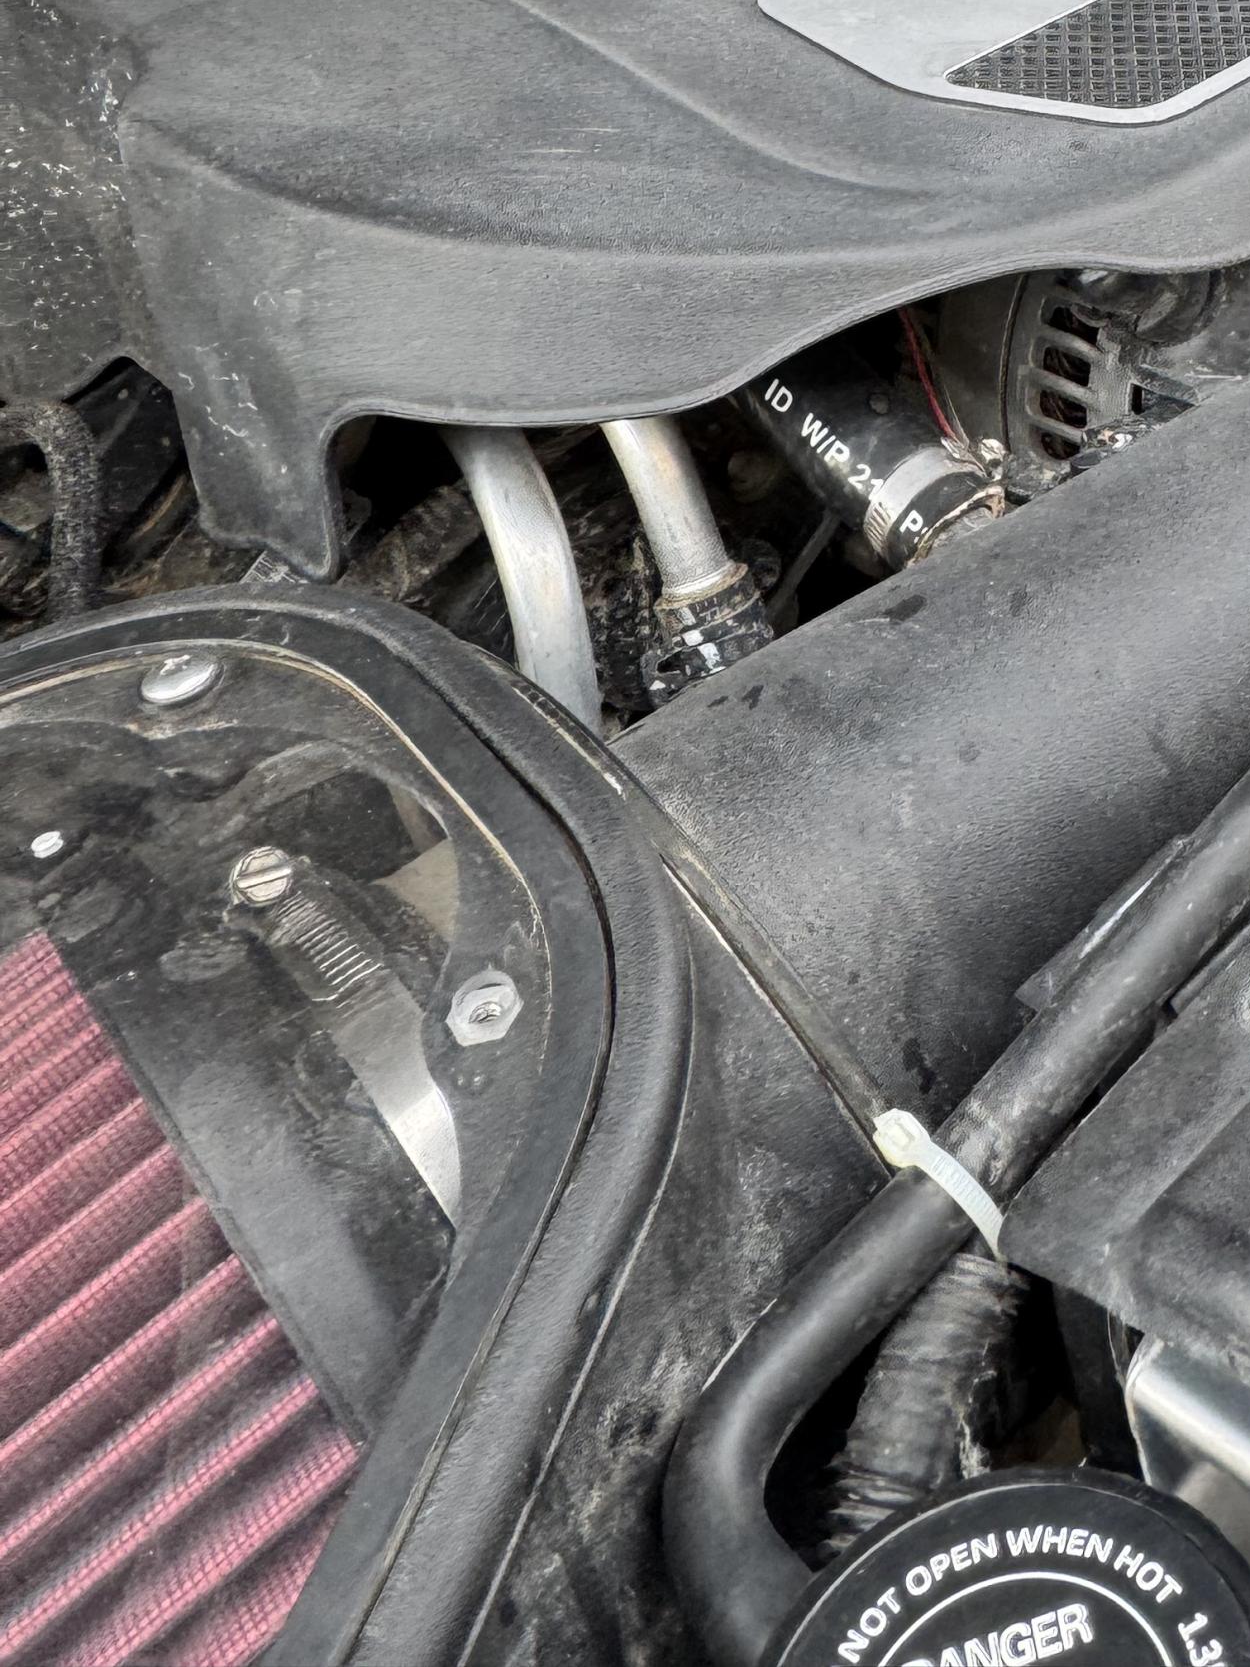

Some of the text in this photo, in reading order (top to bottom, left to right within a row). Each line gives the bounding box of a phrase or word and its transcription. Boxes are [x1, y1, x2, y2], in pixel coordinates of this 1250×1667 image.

[764, 378, 794, 413] ID
[800, 412, 850, 464] W/P
[837, 1586, 901, 1664] NOT
[905, 1532, 998, 1597] OPEN
[1005, 1524, 1114, 1564] WHEN
[1113, 1544, 1184, 1604] HOT
[900, 1602, 1094, 1667] ANGER
